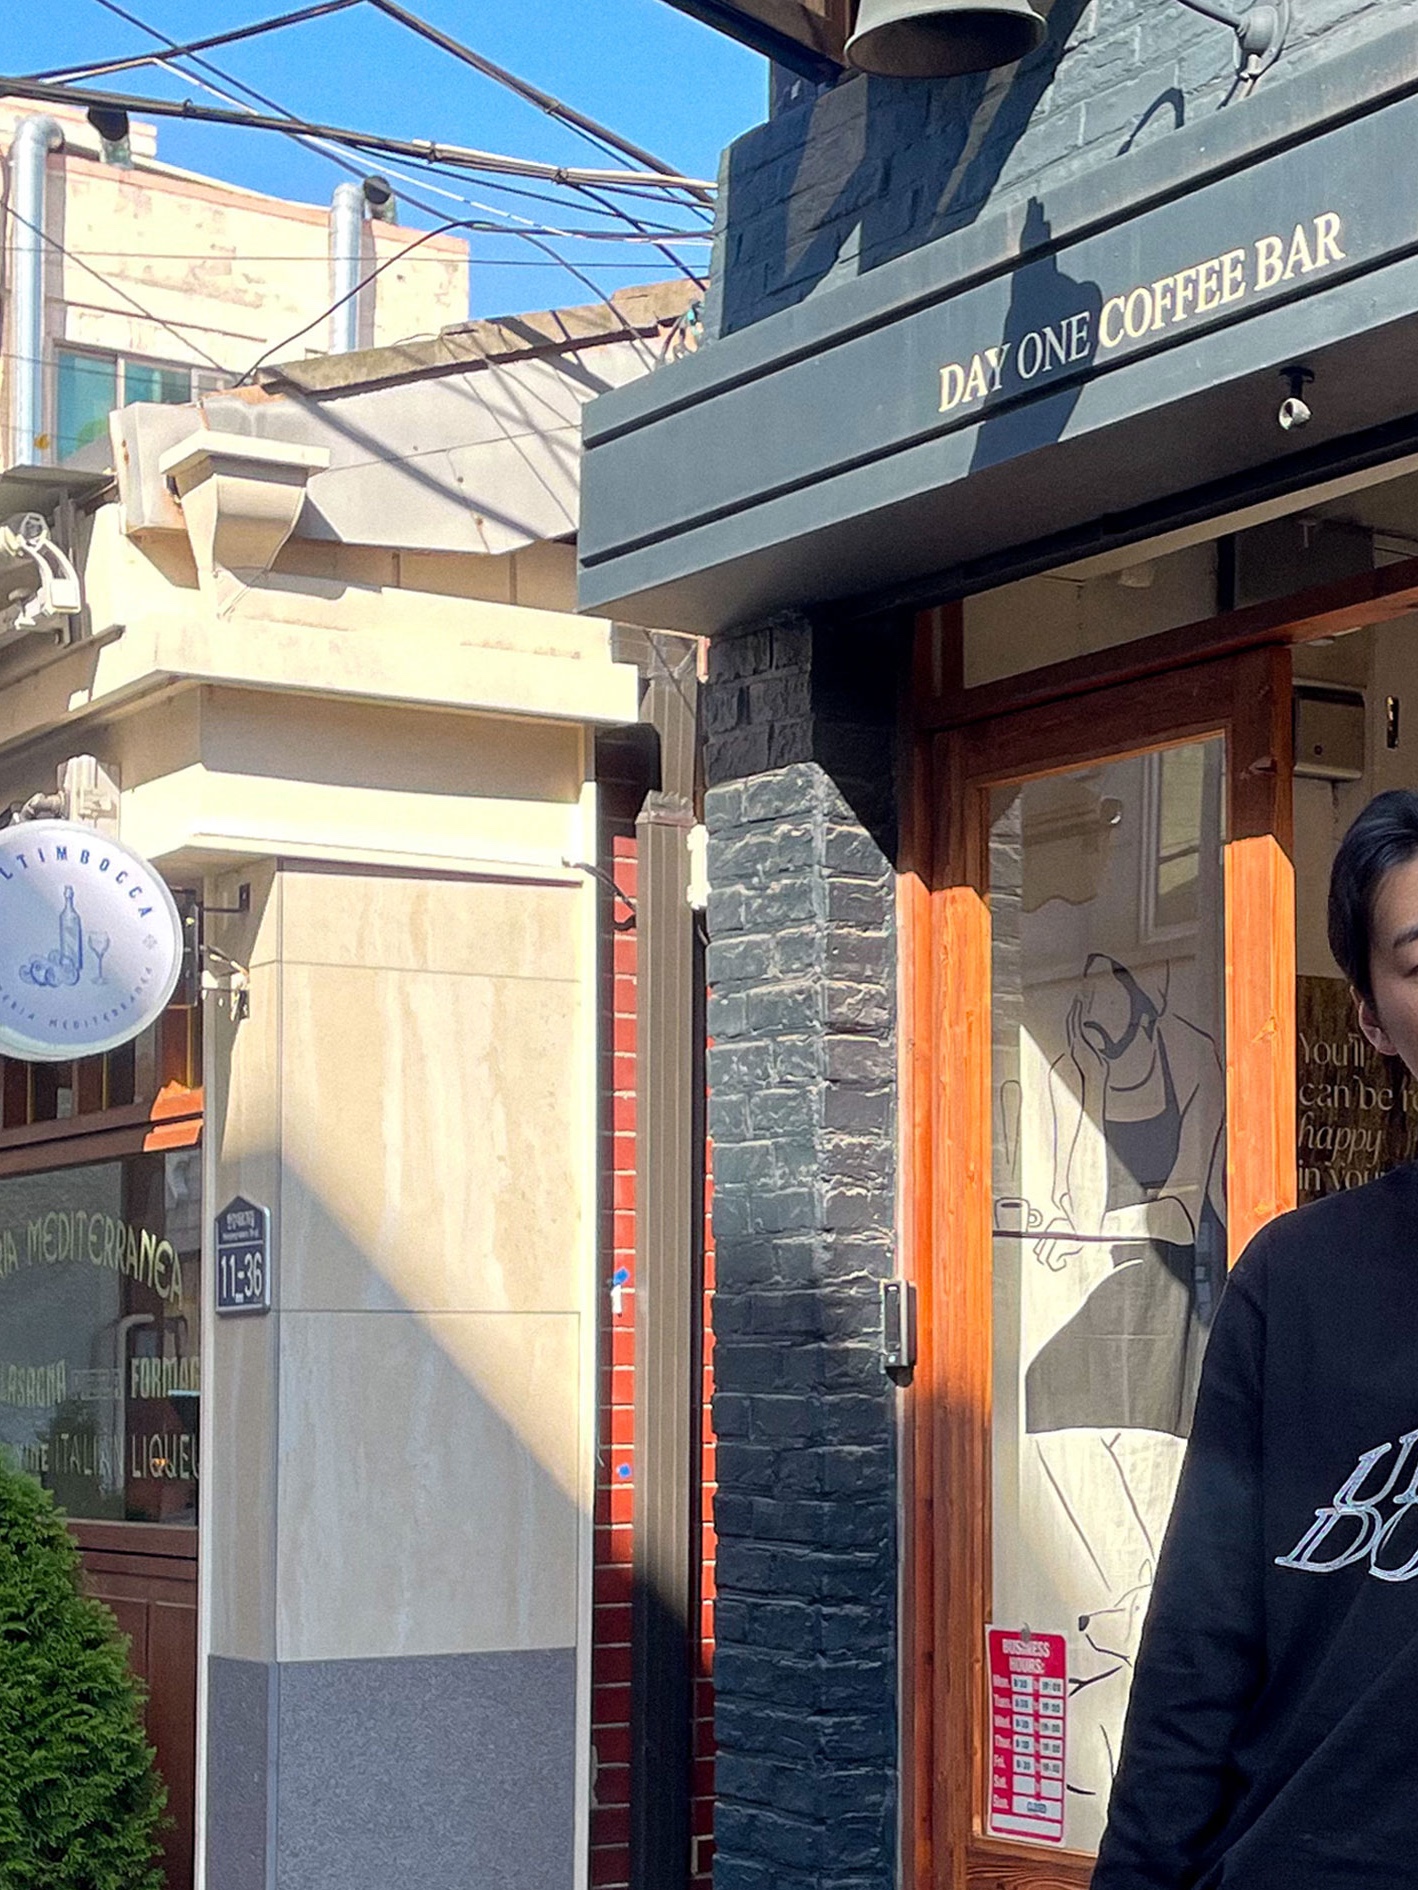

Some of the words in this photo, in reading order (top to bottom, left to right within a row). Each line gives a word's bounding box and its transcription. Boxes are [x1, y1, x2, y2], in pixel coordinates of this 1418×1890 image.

[938, 343, 1011, 412] DAY
[1017, 311, 1091, 379] ONE
[1099, 248, 1247, 349] COFFEE
[1254, 211, 1346, 292] BAR
[1299, 1083, 1350, 1108] can
[1353, 1075, 1394, 1112] be
[1298, 1111, 1382, 1166] happy
[28, 1210, 184, 1314] MEDITERRANEA
[220, 1252, 263, 1300] 11-36
